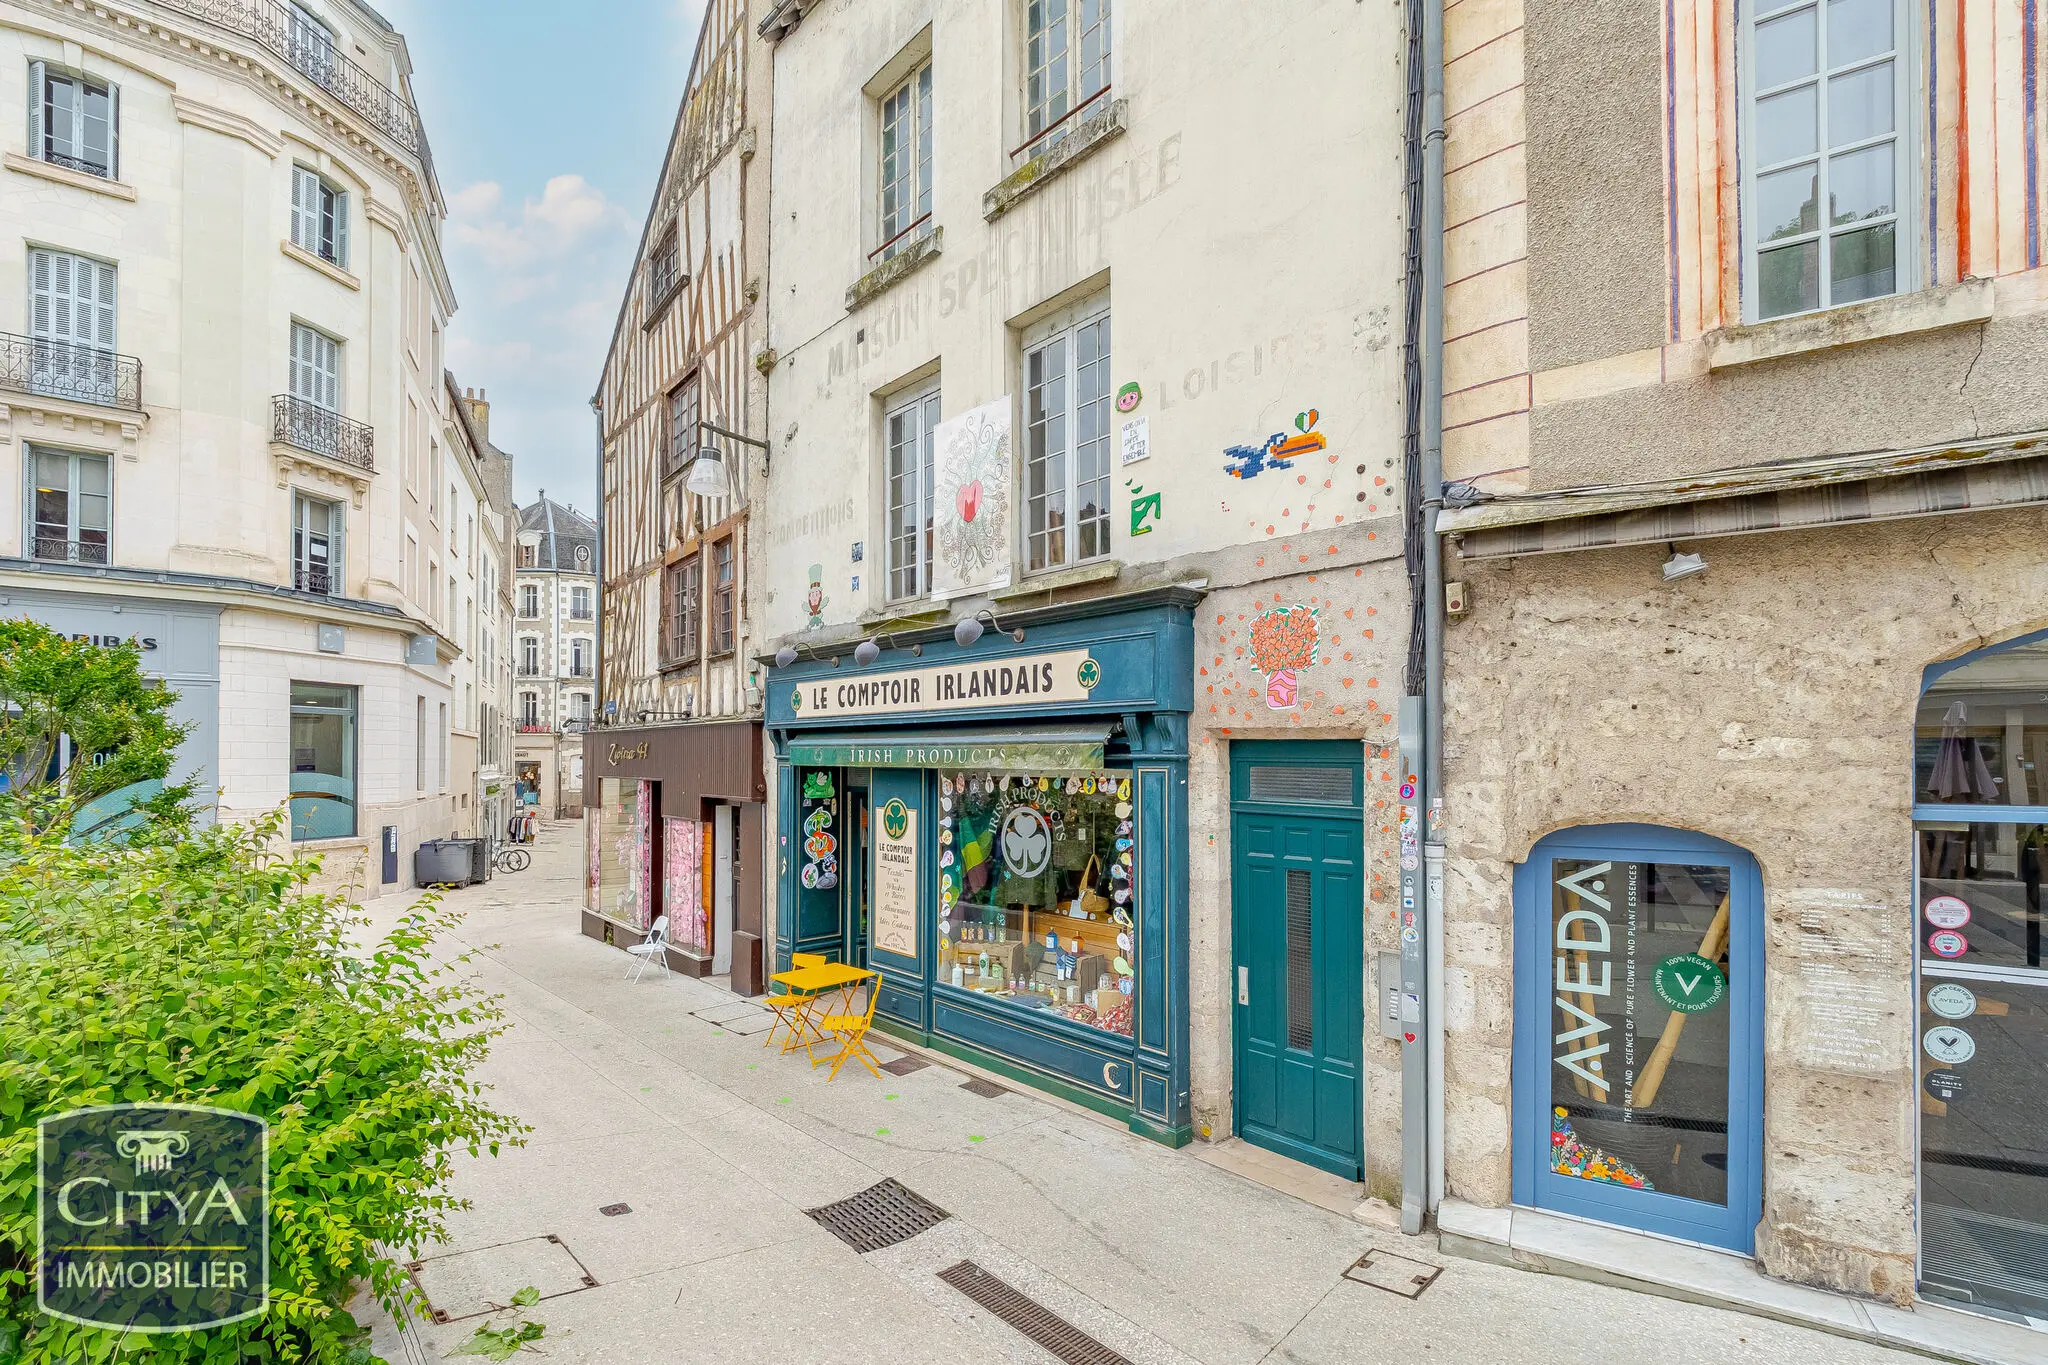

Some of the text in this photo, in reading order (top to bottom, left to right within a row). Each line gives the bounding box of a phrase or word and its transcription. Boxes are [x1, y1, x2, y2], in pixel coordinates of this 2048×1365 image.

[813, 662, 1054, 710] LE COMPTOIR IRLANDAIS
[850, 748, 1006, 763] IRISH PRODUCTS
[988, 786, 1067, 841] IRISH PRODUCTS
[879, 843, 913, 855] LE COMPTOIR
[881, 852, 910, 864] IRLANDAIS
[1827, 891, 1864, 899] TARIFS
[1666, 956, 1712, 971] 100% VEGAN
[1553, 861, 1612, 1092] AVEDA
[1624, 864, 1637, 1123] THE ART AND SCIENCE OF PURE FLOWER AND PLANT ESSENCES
[1655, 968, 1722, 1011] MAINTENANT ET POUR TOUJOURS
[1931, 1079, 1962, 1087] PLANITY
